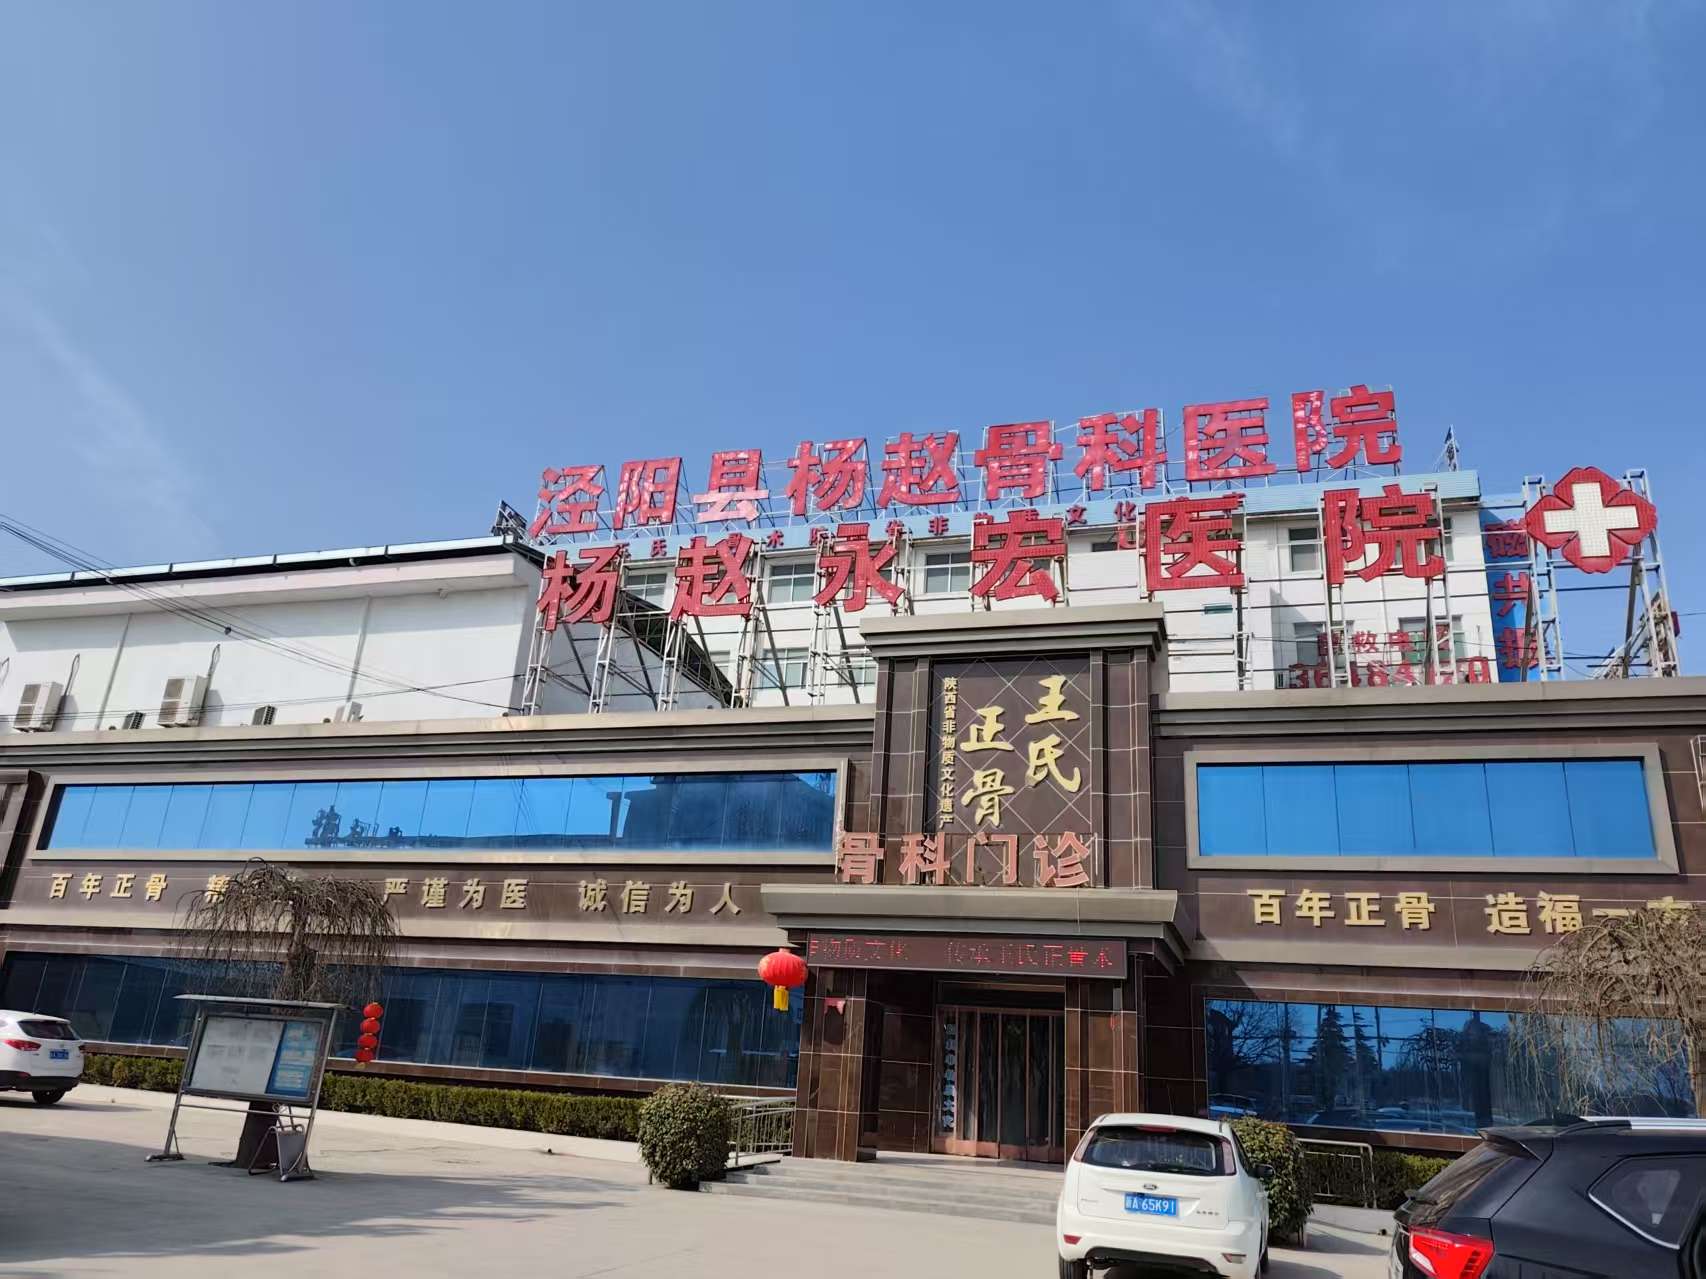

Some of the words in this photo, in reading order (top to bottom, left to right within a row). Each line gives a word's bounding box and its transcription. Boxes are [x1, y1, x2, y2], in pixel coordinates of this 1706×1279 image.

[529, 384, 1402, 538] 泾阳县杨赵骨科医院
[538, 483, 1446, 632] 杨赵永宏医院
[938, 677, 959, 829] 陕西省非物质文化遗产
[960, 705, 1015, 828] 正骨
[1025, 674, 1082, 793] 王氏
[49, 872, 169, 902] 百年正骨
[382, 876, 529, 910] 严谨为医
[578, 878, 742, 916] 诚信为人
[839, 830, 1091, 888] 骨科门诊
[1247, 888, 1435, 931] 百年正骨
